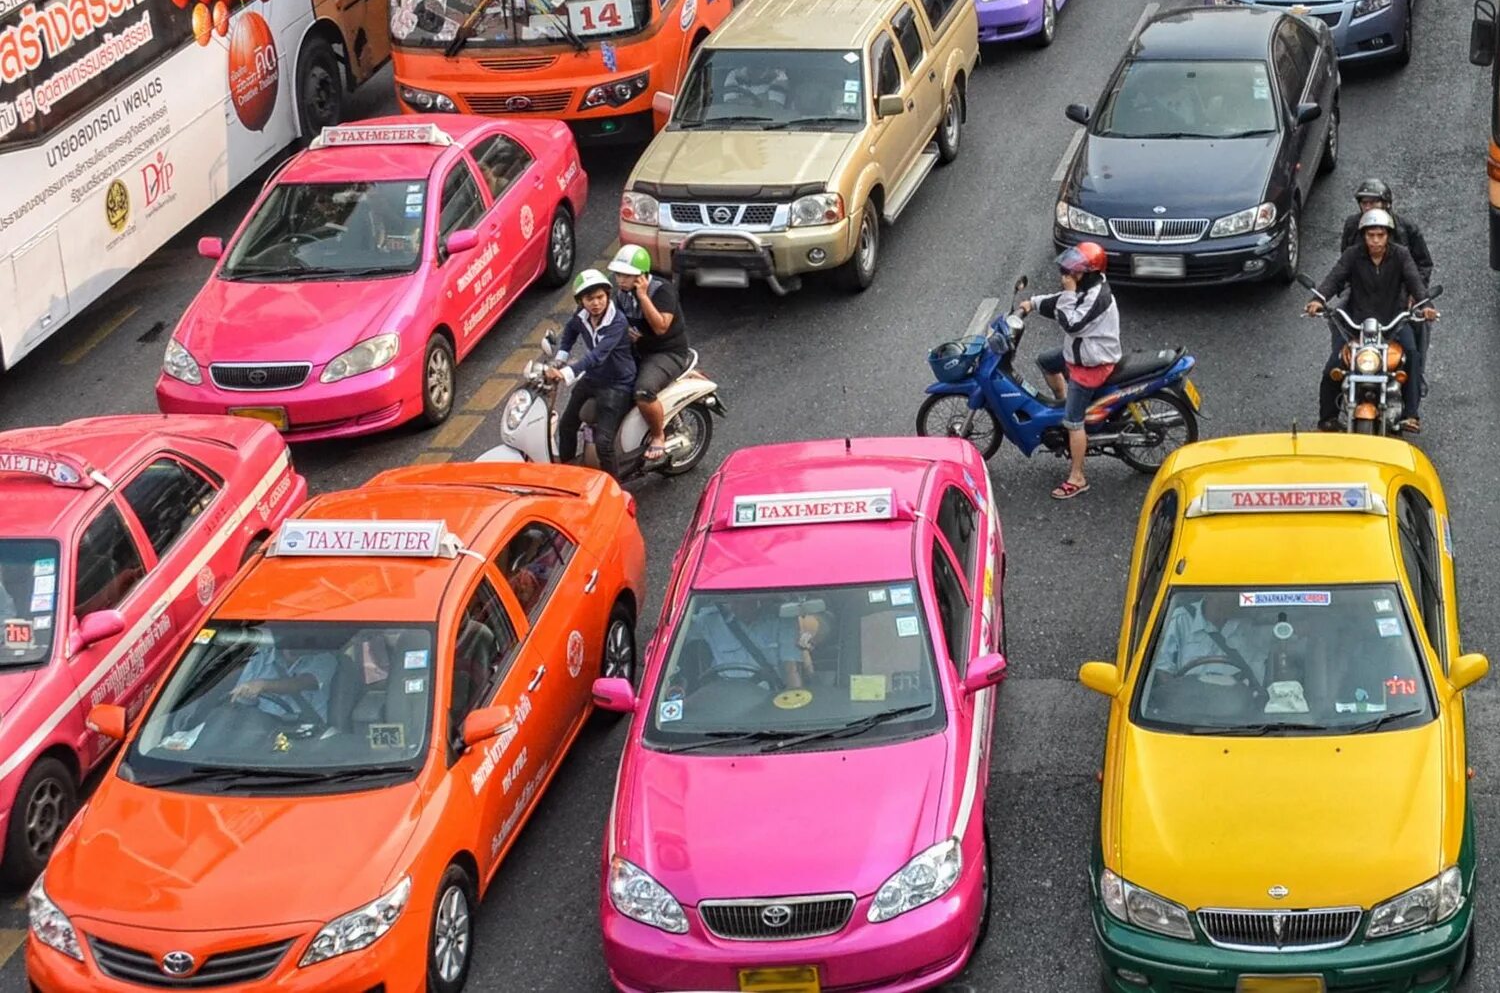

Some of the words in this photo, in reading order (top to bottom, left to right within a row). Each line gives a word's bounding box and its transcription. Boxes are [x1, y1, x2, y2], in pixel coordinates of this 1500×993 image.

[580, 2, 622, 31] 14
[17, 90, 35, 121] 15
[341, 130, 416, 142] TAXI-METER
[758, 501, 868, 520] TAXI-METER
[1231, 492, 1343, 507] TAXI-METER
[305, 529, 431, 551] TAXI-METER
[1386, 674, 1417, 696] ว่าง
